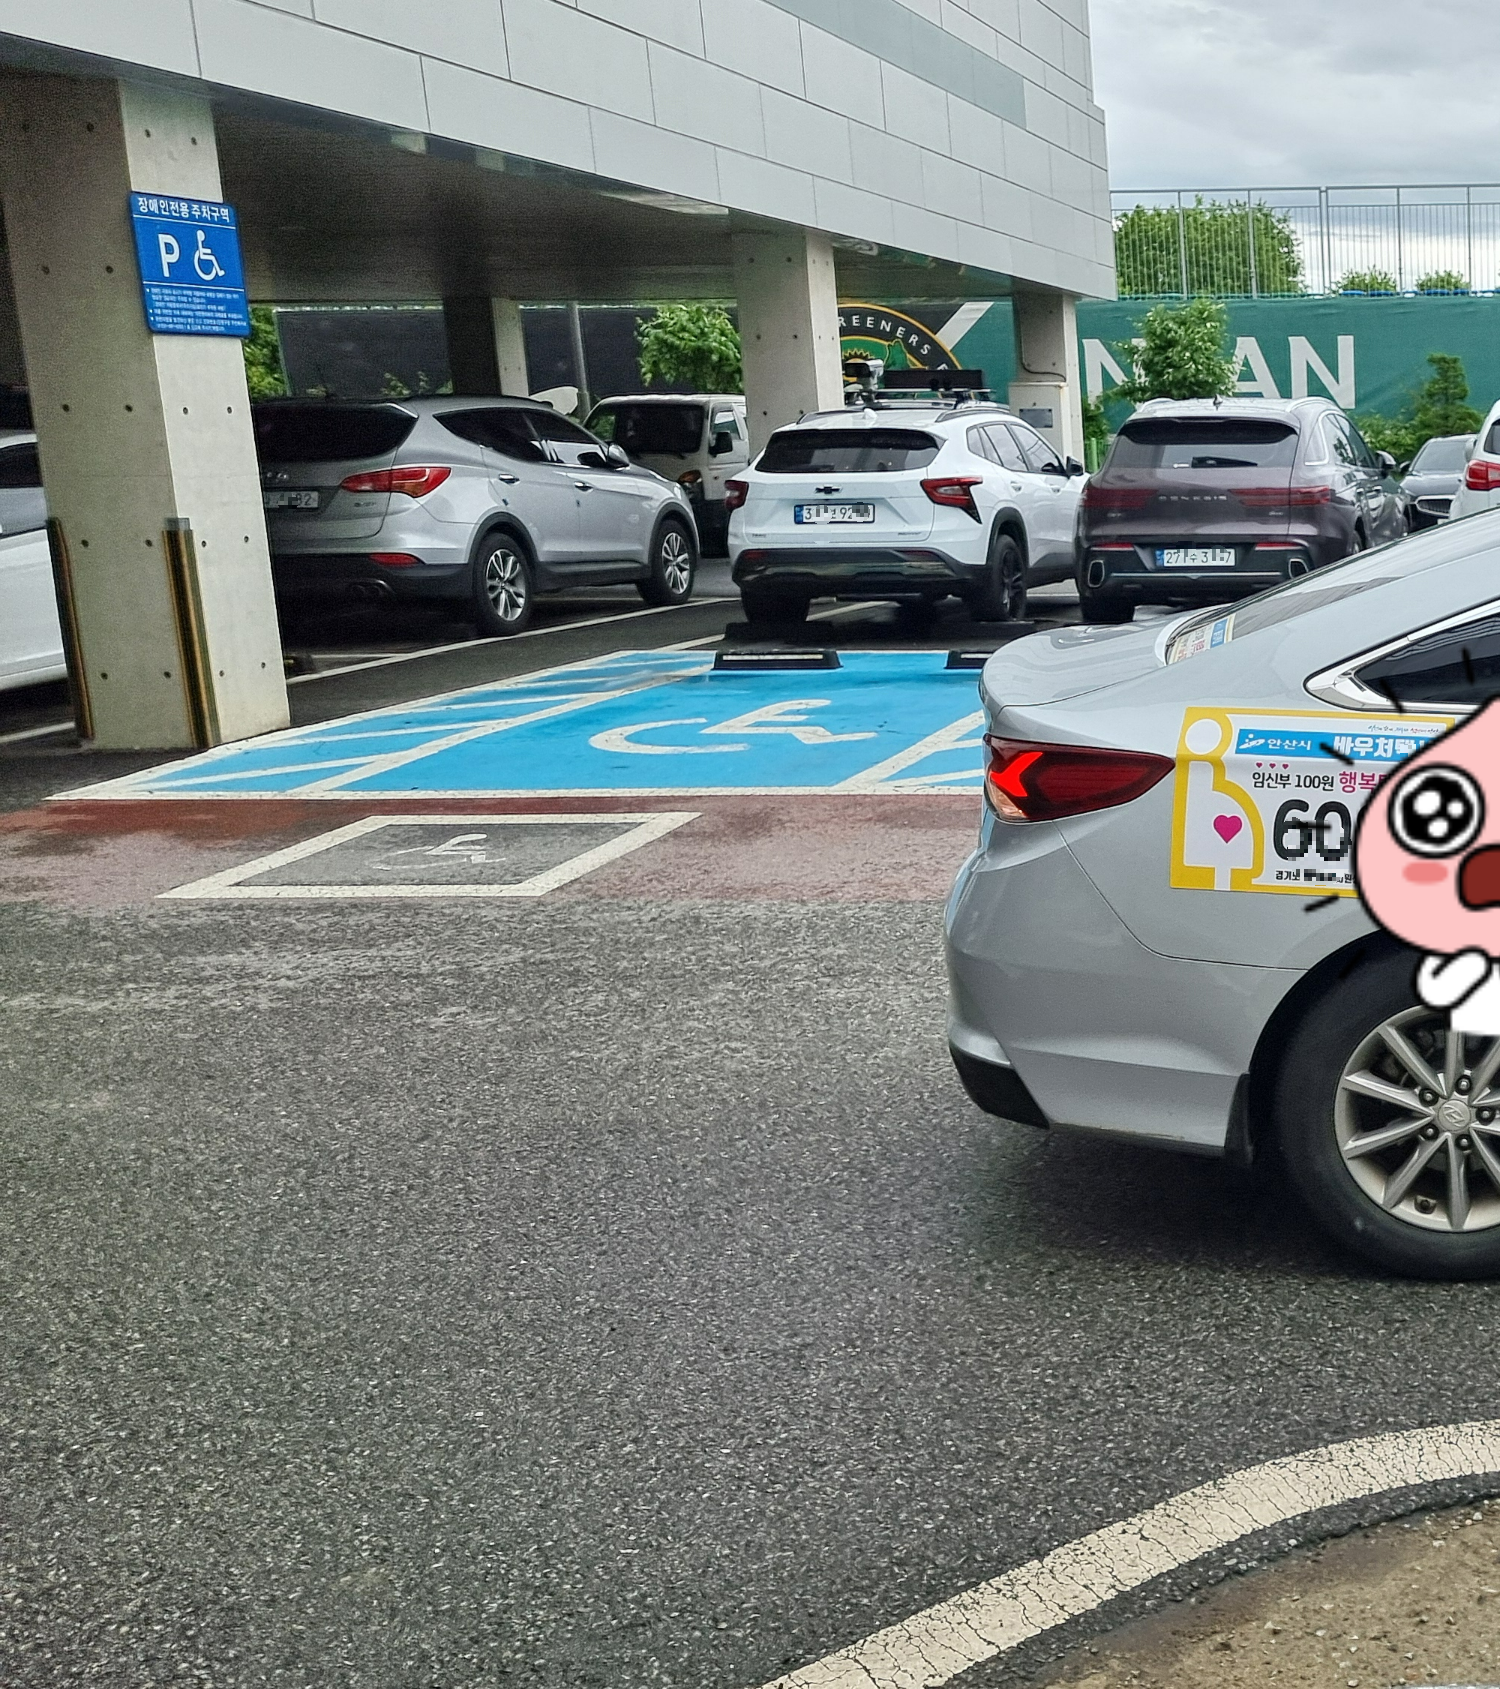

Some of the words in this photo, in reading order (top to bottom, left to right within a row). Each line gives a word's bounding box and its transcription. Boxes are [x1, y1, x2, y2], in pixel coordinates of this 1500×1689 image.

[138, 197, 190, 218] 장애인전용
[191, 204, 230, 223] 주차구역
[158, 233, 181, 277] P
[838, 315, 932, 355] REENERS
[1267, 738, 1312, 750] 안산시
[1252, 771, 1292, 789] 임신부
[1294, 774, 1335, 791] 100원
[1339, 770, 1386, 794] 행복
